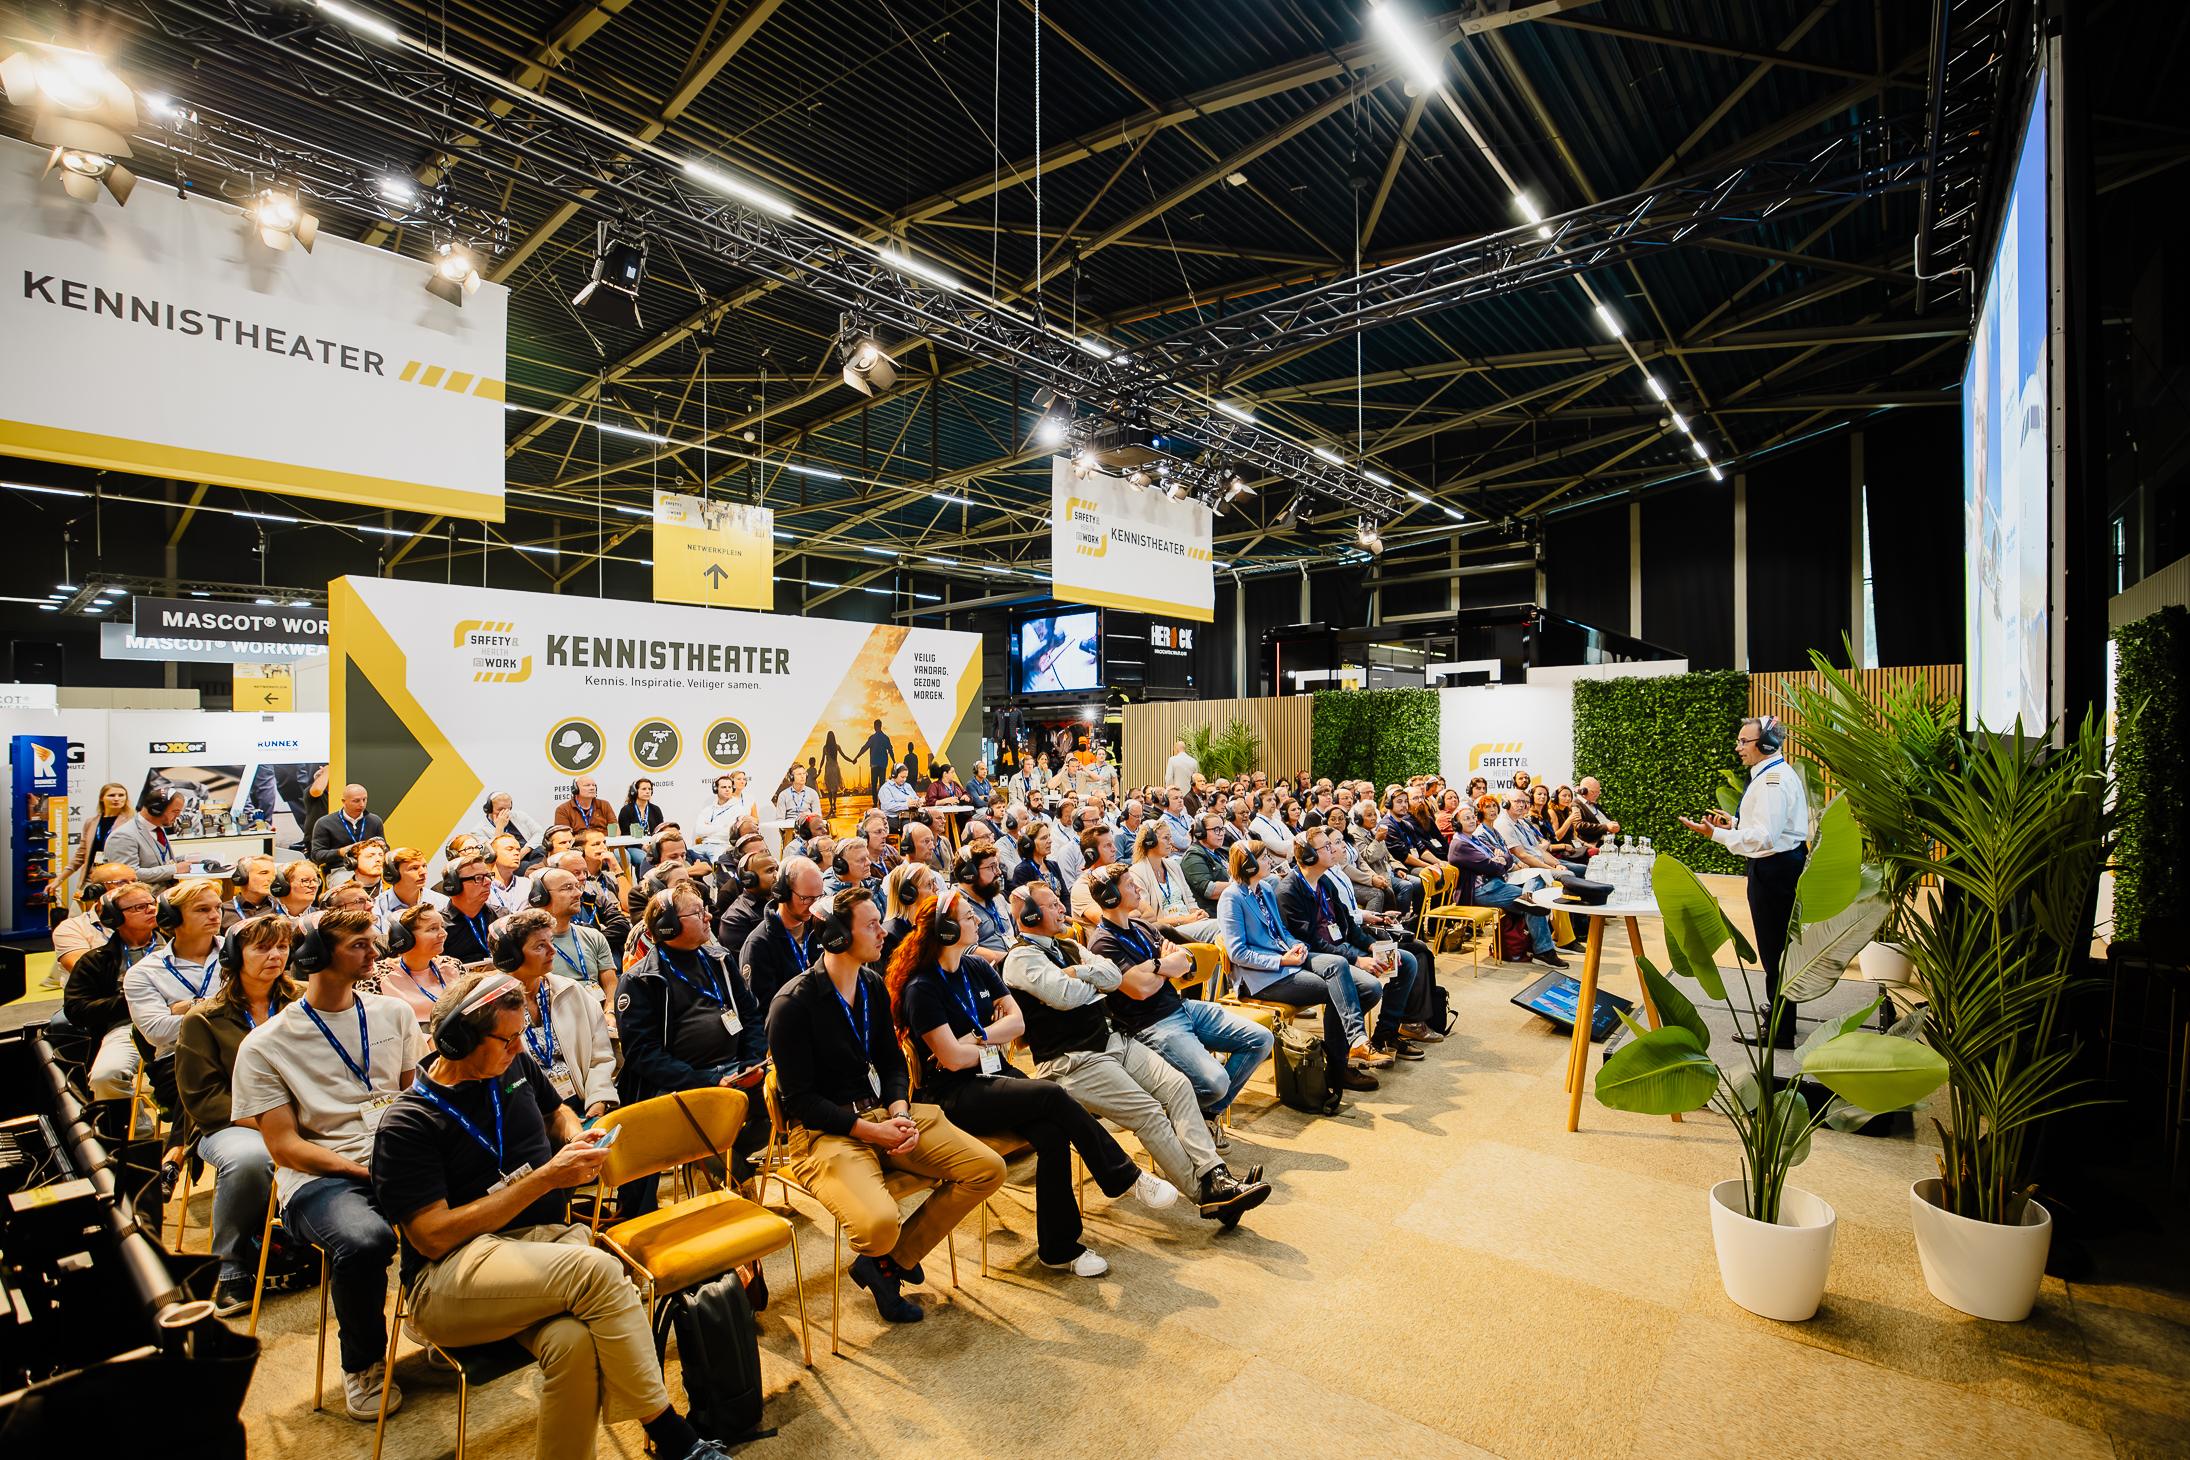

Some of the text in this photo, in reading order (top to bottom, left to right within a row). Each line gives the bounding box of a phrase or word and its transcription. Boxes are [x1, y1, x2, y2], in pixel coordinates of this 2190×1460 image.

[23, 269, 386, 377] KENNISTHEATER
[1111, 527, 1185, 556] KENNISTHEATER
[687, 543, 742, 557] NETWERKPLEIN
[282, 617, 329, 635] WOR
[231, 641, 329, 657] WORKWEA
[546, 634, 791, 675] KENNISTHEATER
[913, 652, 936, 663] VEILIG
[913, 665, 949, 676] VANDAAG.
[585, 675, 762, 691] Kennis. Inspiratie. Veiliger samen.
[913, 678, 941, 688] GEZOND
[913, 690, 945, 700] MORGEN.
